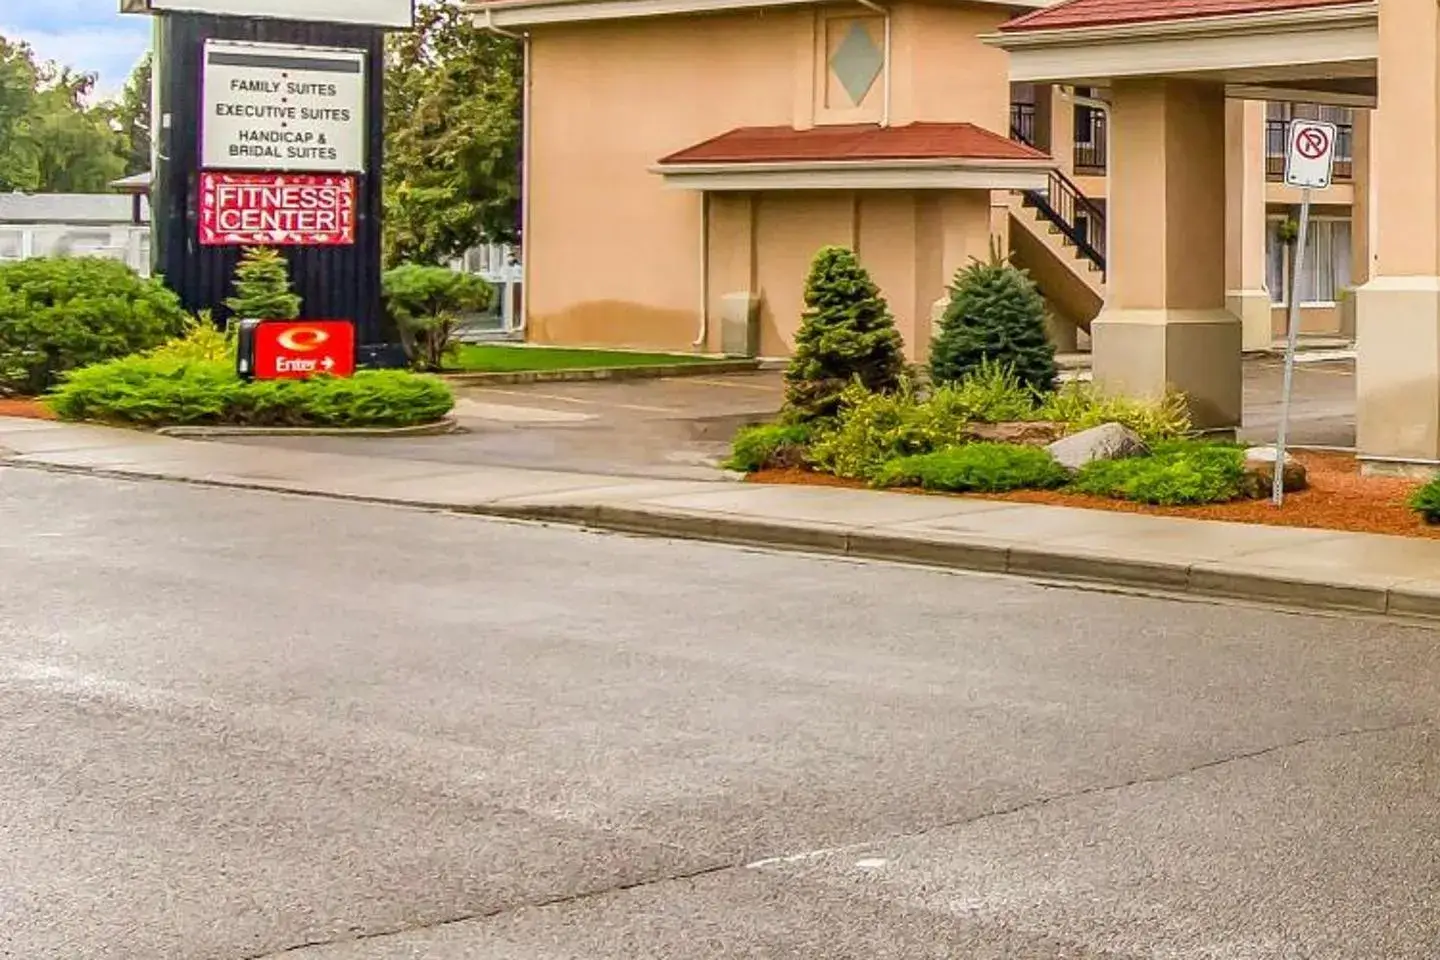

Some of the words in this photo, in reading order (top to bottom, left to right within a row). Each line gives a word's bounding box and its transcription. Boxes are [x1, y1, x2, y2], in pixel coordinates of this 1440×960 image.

[230, 79, 280, 92] FAMILY
[287, 82, 336, 96] SUITES
[216, 103, 295, 119] EXECUTIVE
[300, 107, 350, 121] SUITES
[239, 130, 314, 144] HANDICAP
[319, 133, 327, 145] &
[229, 145, 281, 158] BRIDAL
[287, 146, 336, 160] SUITES
[219, 187, 336, 208] FITNESS
[220, 210, 335, 230] CENTER
[276, 356, 317, 372] Enter
